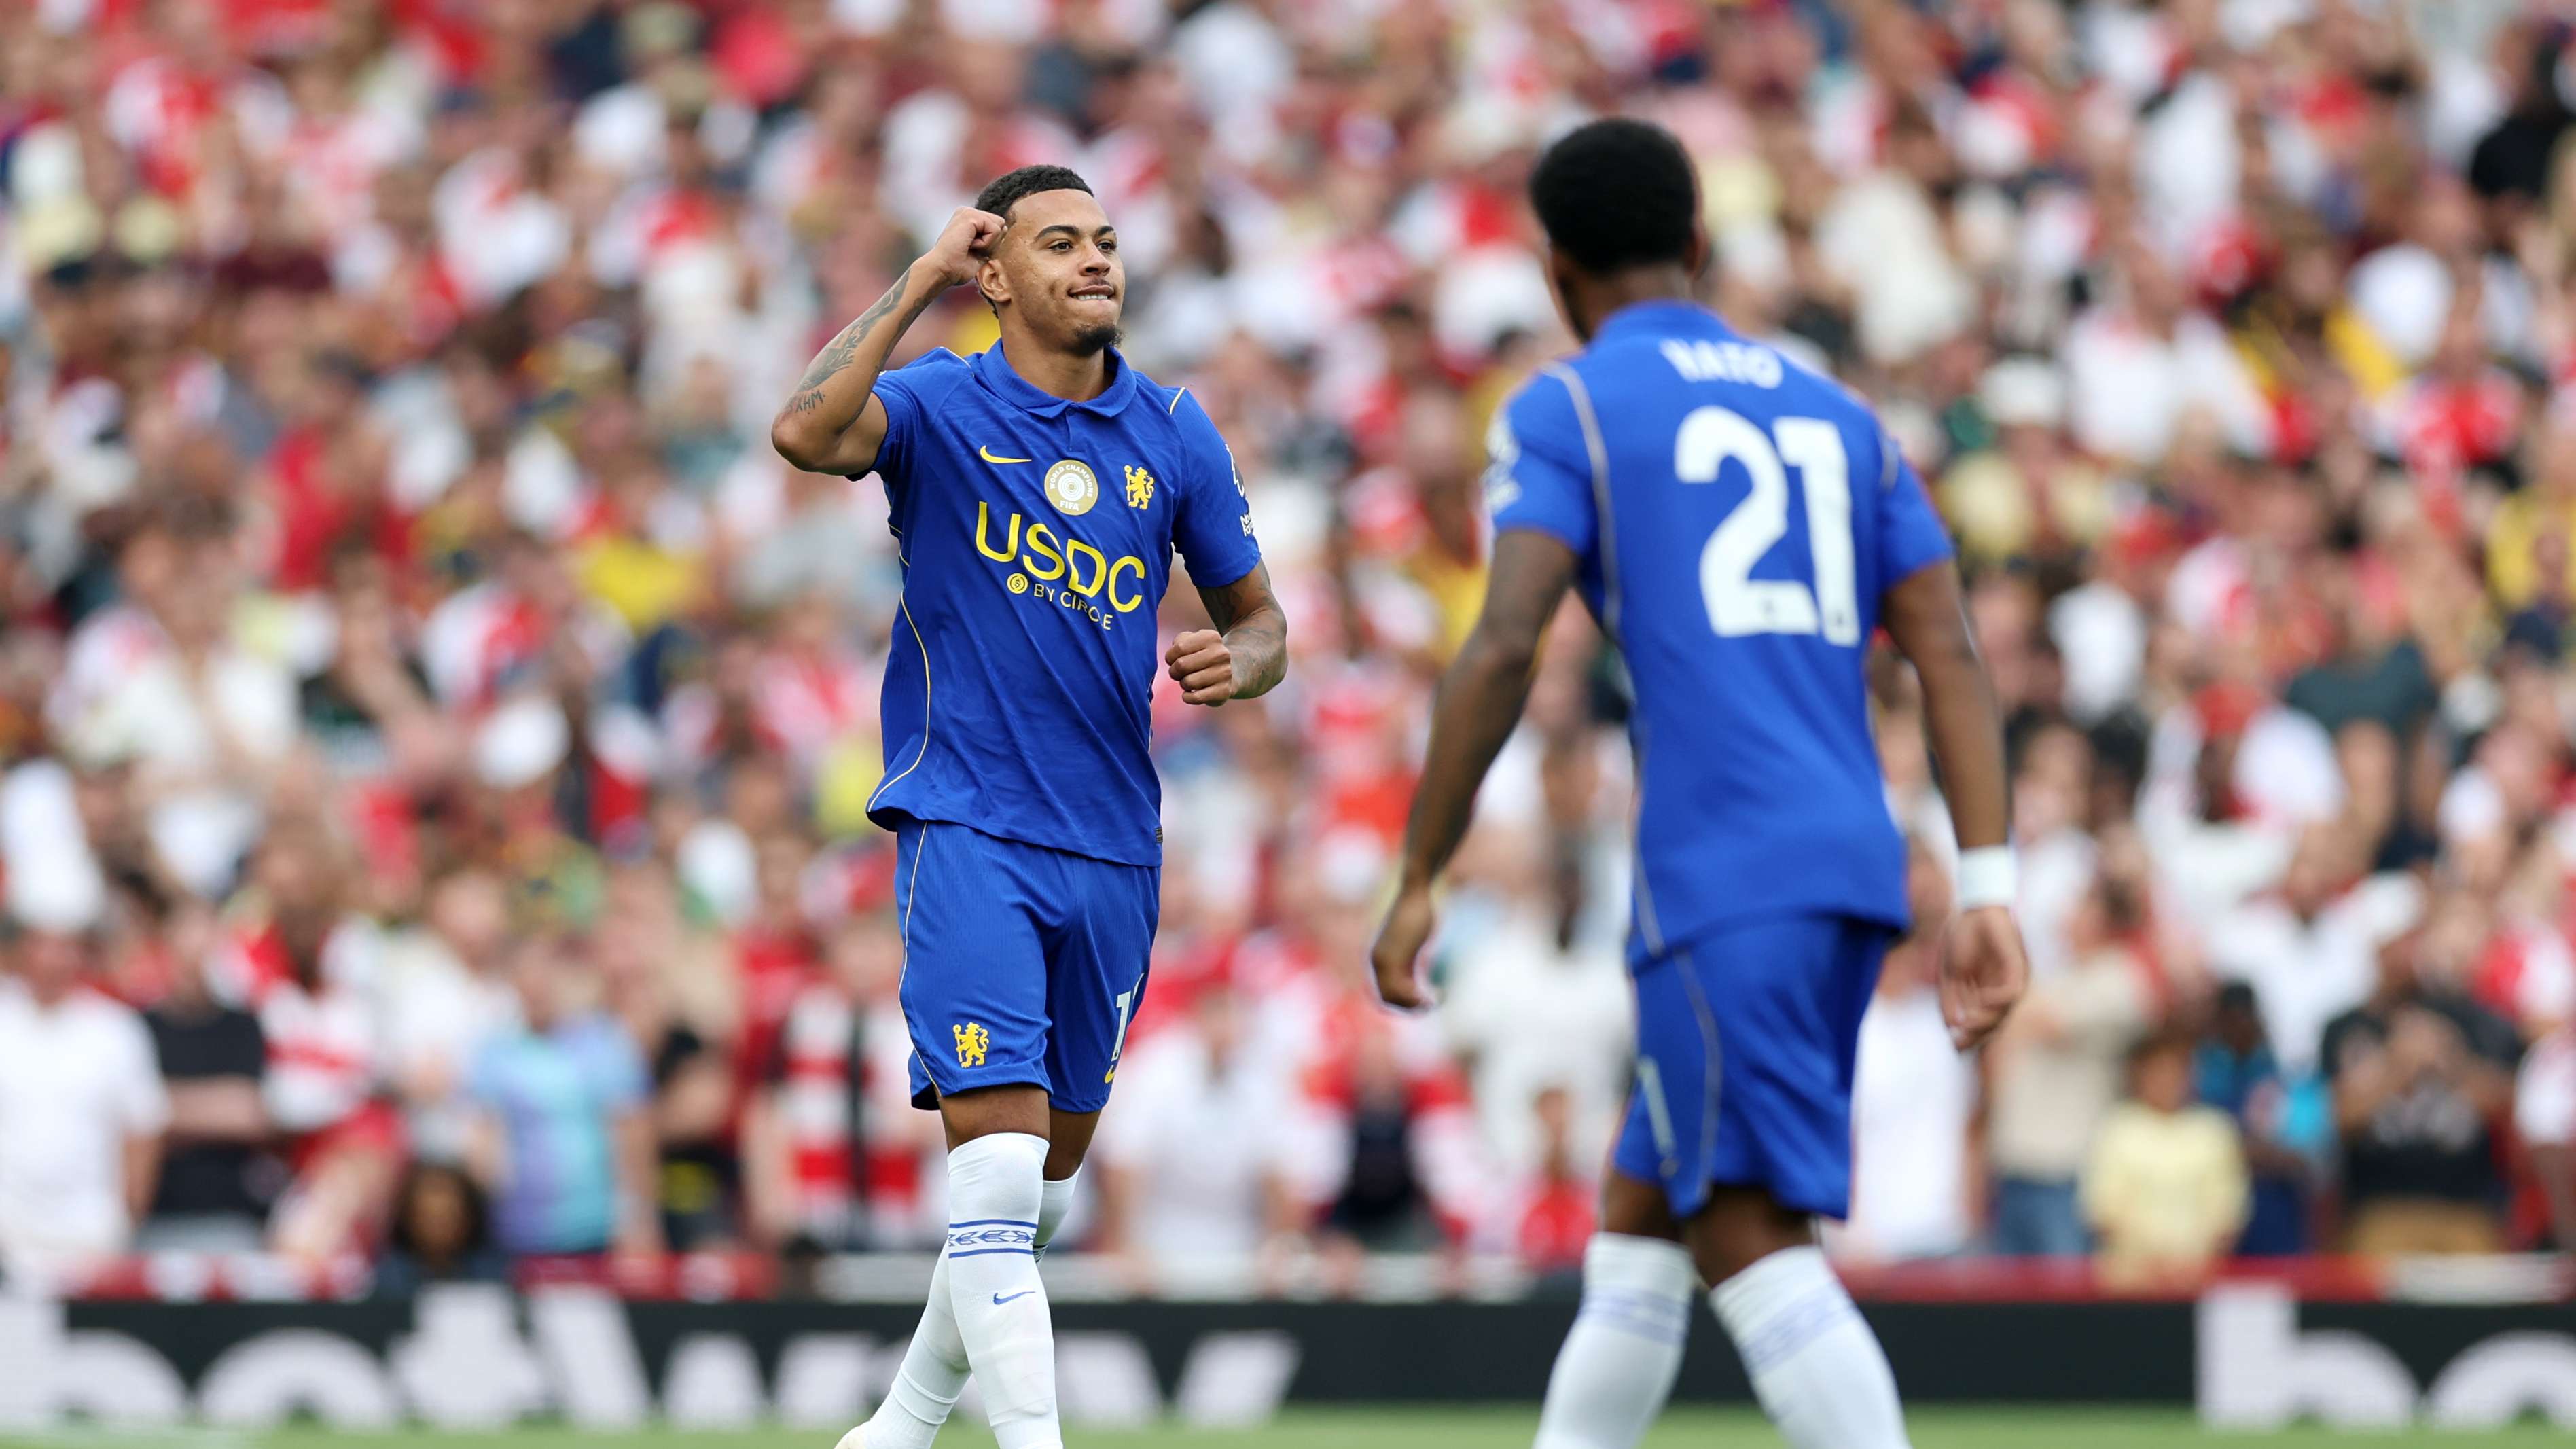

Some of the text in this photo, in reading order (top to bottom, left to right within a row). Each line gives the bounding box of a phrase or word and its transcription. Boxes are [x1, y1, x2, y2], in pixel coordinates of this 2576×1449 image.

[1050, 465, 1093, 497] WORLD CHAMPIONS
[1060, 500, 1079, 512] FIFA
[976, 501, 1145, 613] USDC
[1675, 405, 1860, 648] 21
[1033, 583, 1113, 630] BY CIRCE
[1111, 973, 1145, 1062] 1
